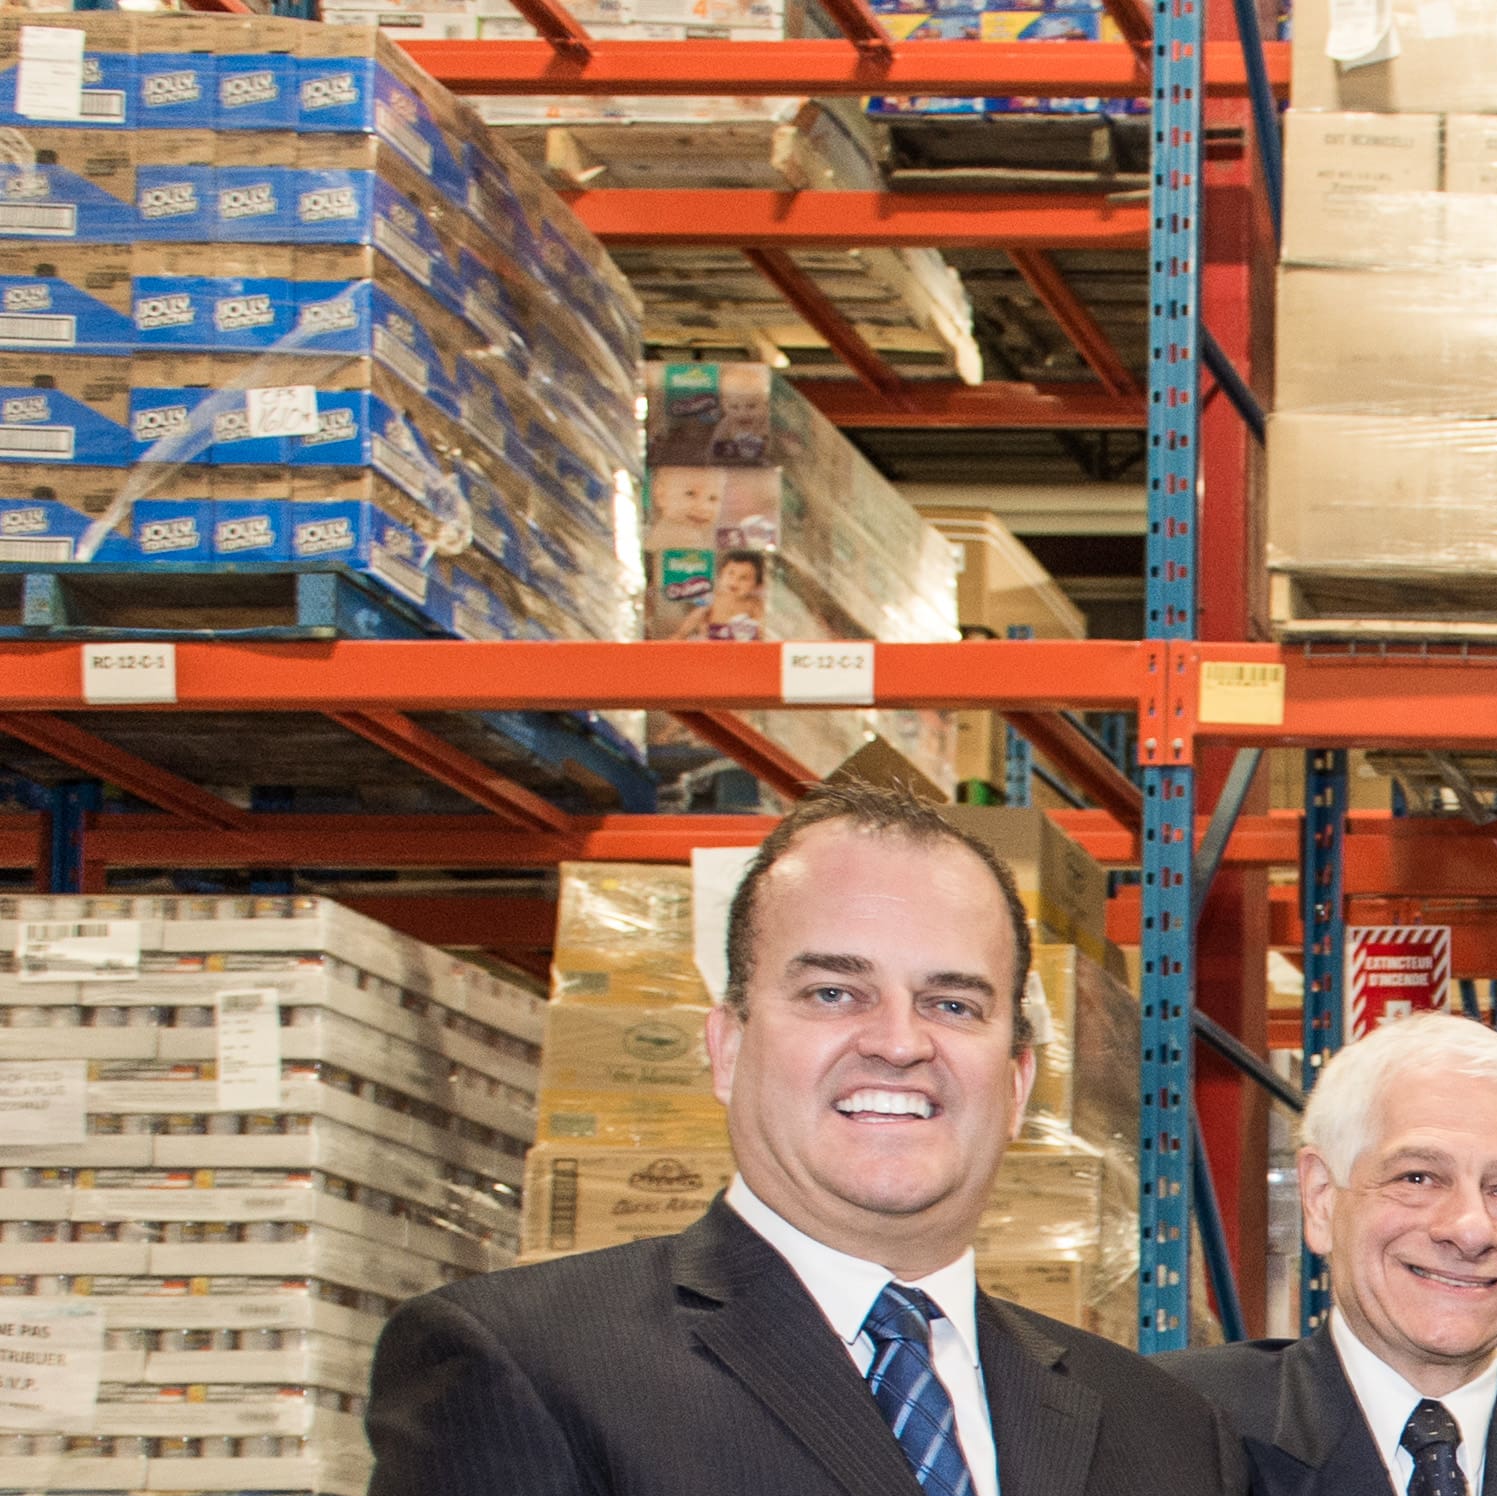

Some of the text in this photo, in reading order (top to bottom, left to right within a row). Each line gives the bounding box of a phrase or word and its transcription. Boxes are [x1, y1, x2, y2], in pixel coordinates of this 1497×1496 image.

[92, 655, 165, 669] RC-12-C-1
[791, 655, 865, 669] RC-12-C-2
[1364, 956, 1433, 970] EXTINCTEUR
